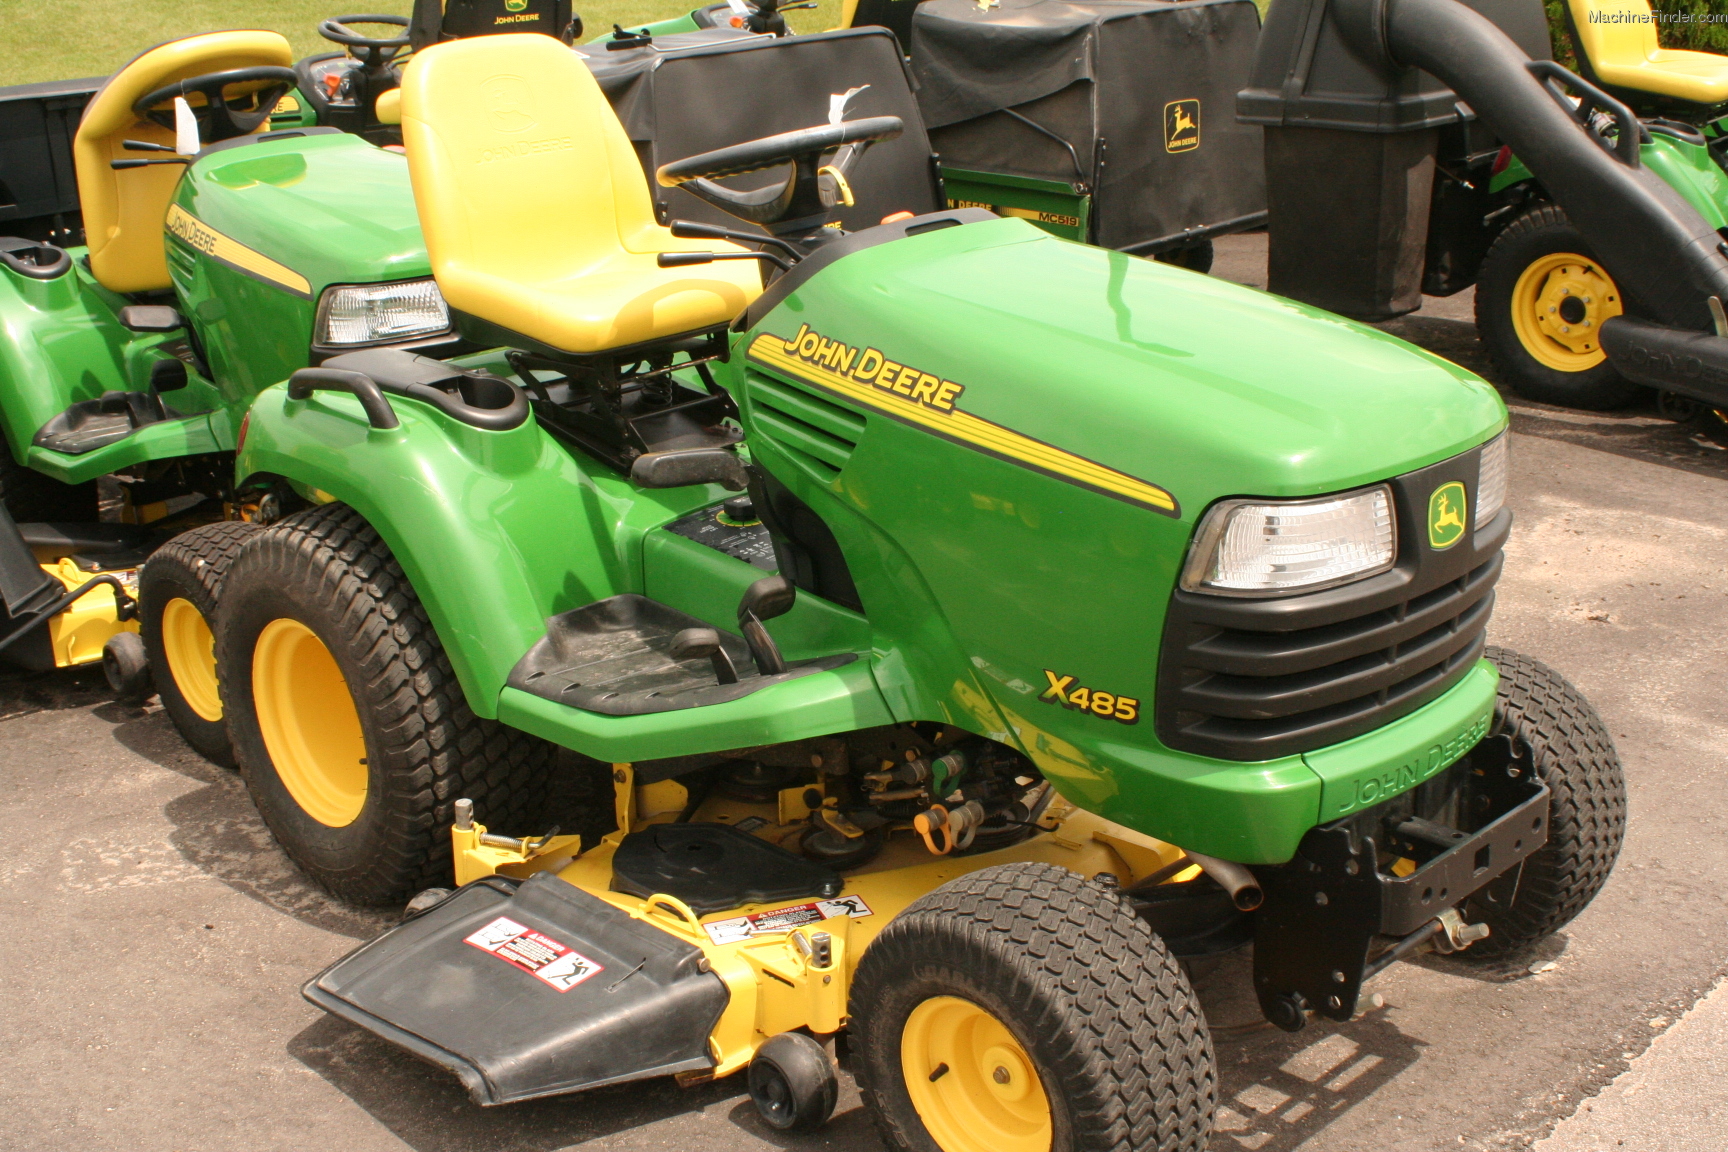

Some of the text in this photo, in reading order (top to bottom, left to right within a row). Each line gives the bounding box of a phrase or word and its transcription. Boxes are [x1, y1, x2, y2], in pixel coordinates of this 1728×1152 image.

[494, 13, 540, 25] JOHN DEERE
[517, 136, 573, 158] DEERE
[171, 211, 217, 254] JOHN DEERE
[1039, 212, 1077, 226] MC519
[784, 322, 965, 414] JOHN DEERE
[1039, 669, 1139, 723] X485
[1339, 711, 1489, 813] JOHN DEERE
[767, 904, 808, 917] DANGER
